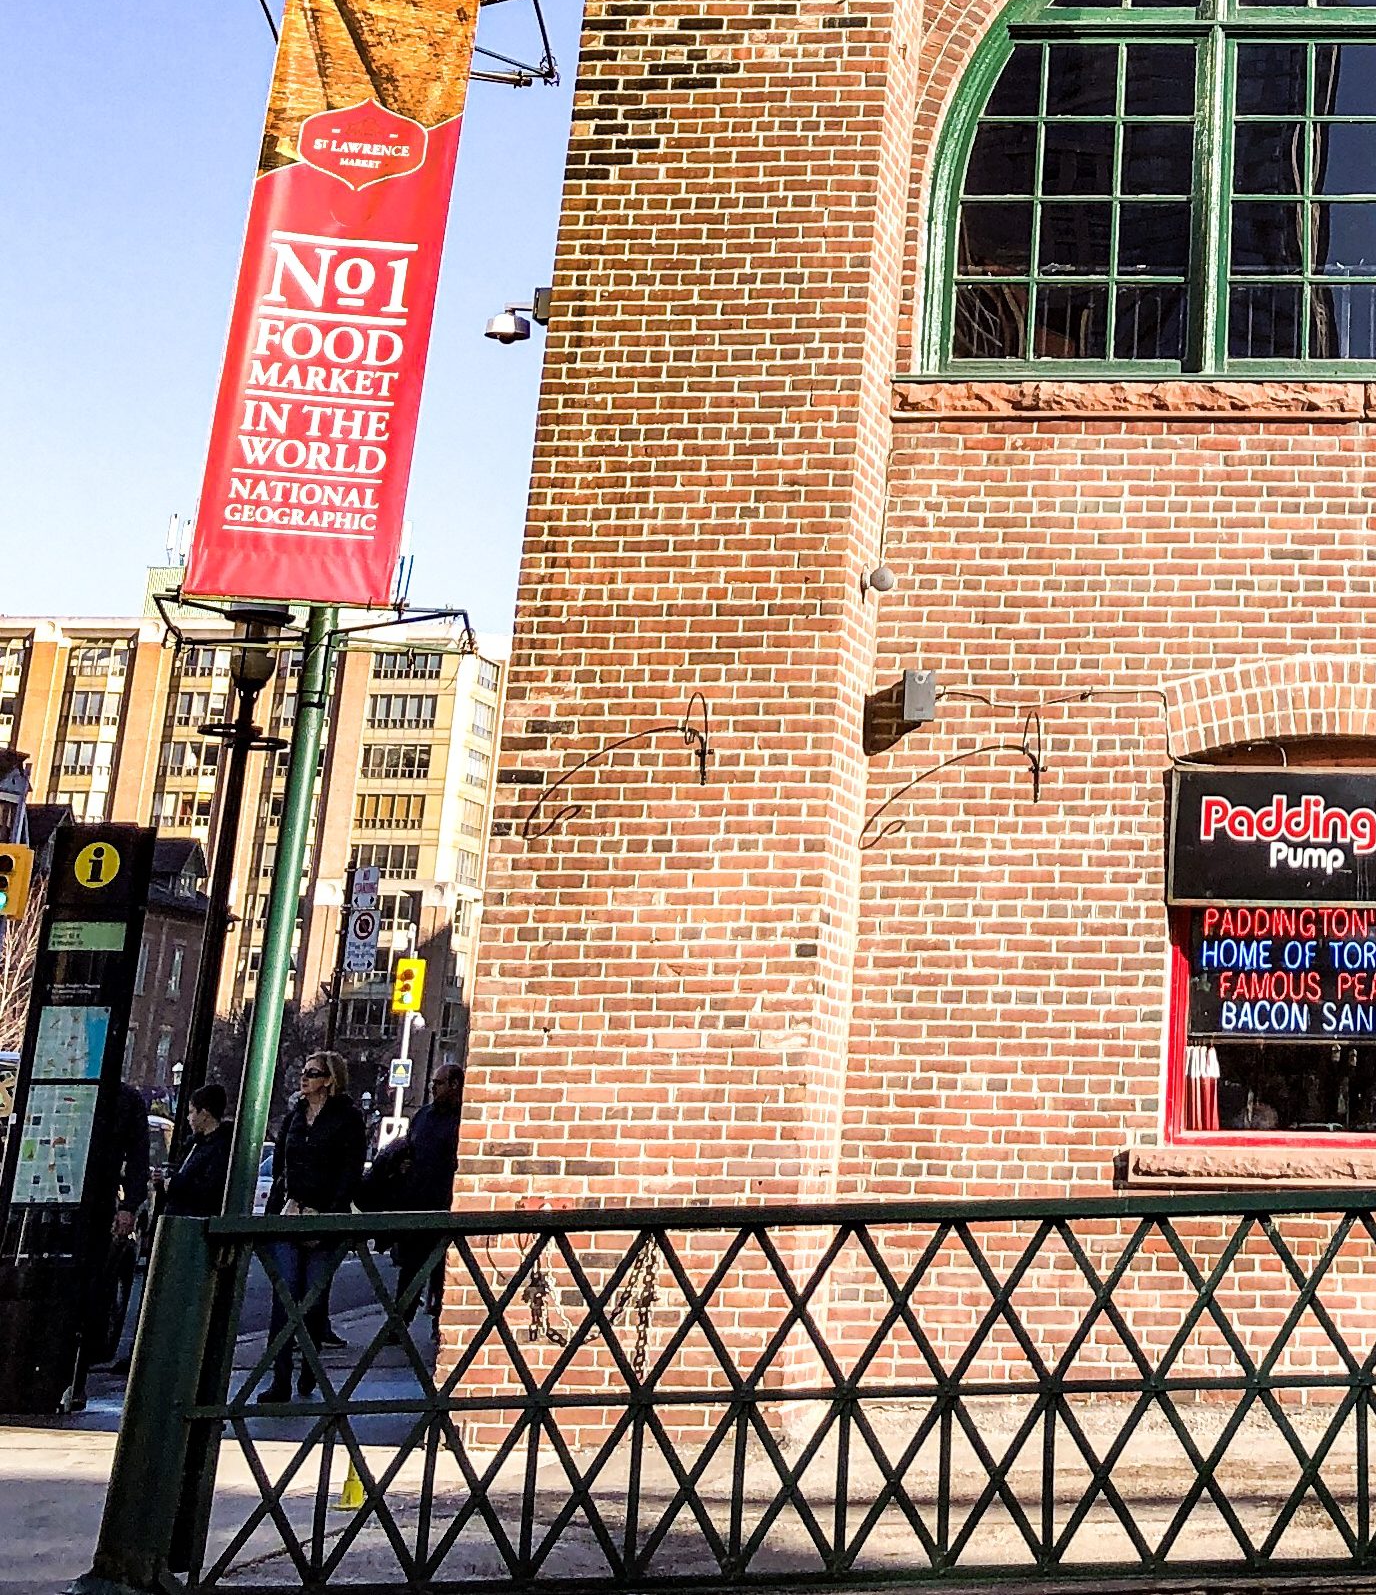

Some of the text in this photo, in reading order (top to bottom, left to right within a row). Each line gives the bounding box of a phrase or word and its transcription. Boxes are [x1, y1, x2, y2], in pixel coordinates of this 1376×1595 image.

[330, 140, 410, 157] LAWRENCE
[339, 157, 382, 169] MARKET
[251, 318, 404, 366] FOOD
[247, 359, 399, 397] MARKET
[239, 399, 391, 442] IN THE
[237, 434, 388, 475] WORLD
[228, 477, 380, 510] NATIONAL
[223, 503, 378, 532] GEOGRAPHIC
[1270, 841, 1346, 875] Pump
[1202, 939, 1272, 970] HOME
[1283, 939, 1318, 970] OF
[1219, 970, 1322, 1002] FAMOUS
[1221, 1001, 1309, 1032] BACON
